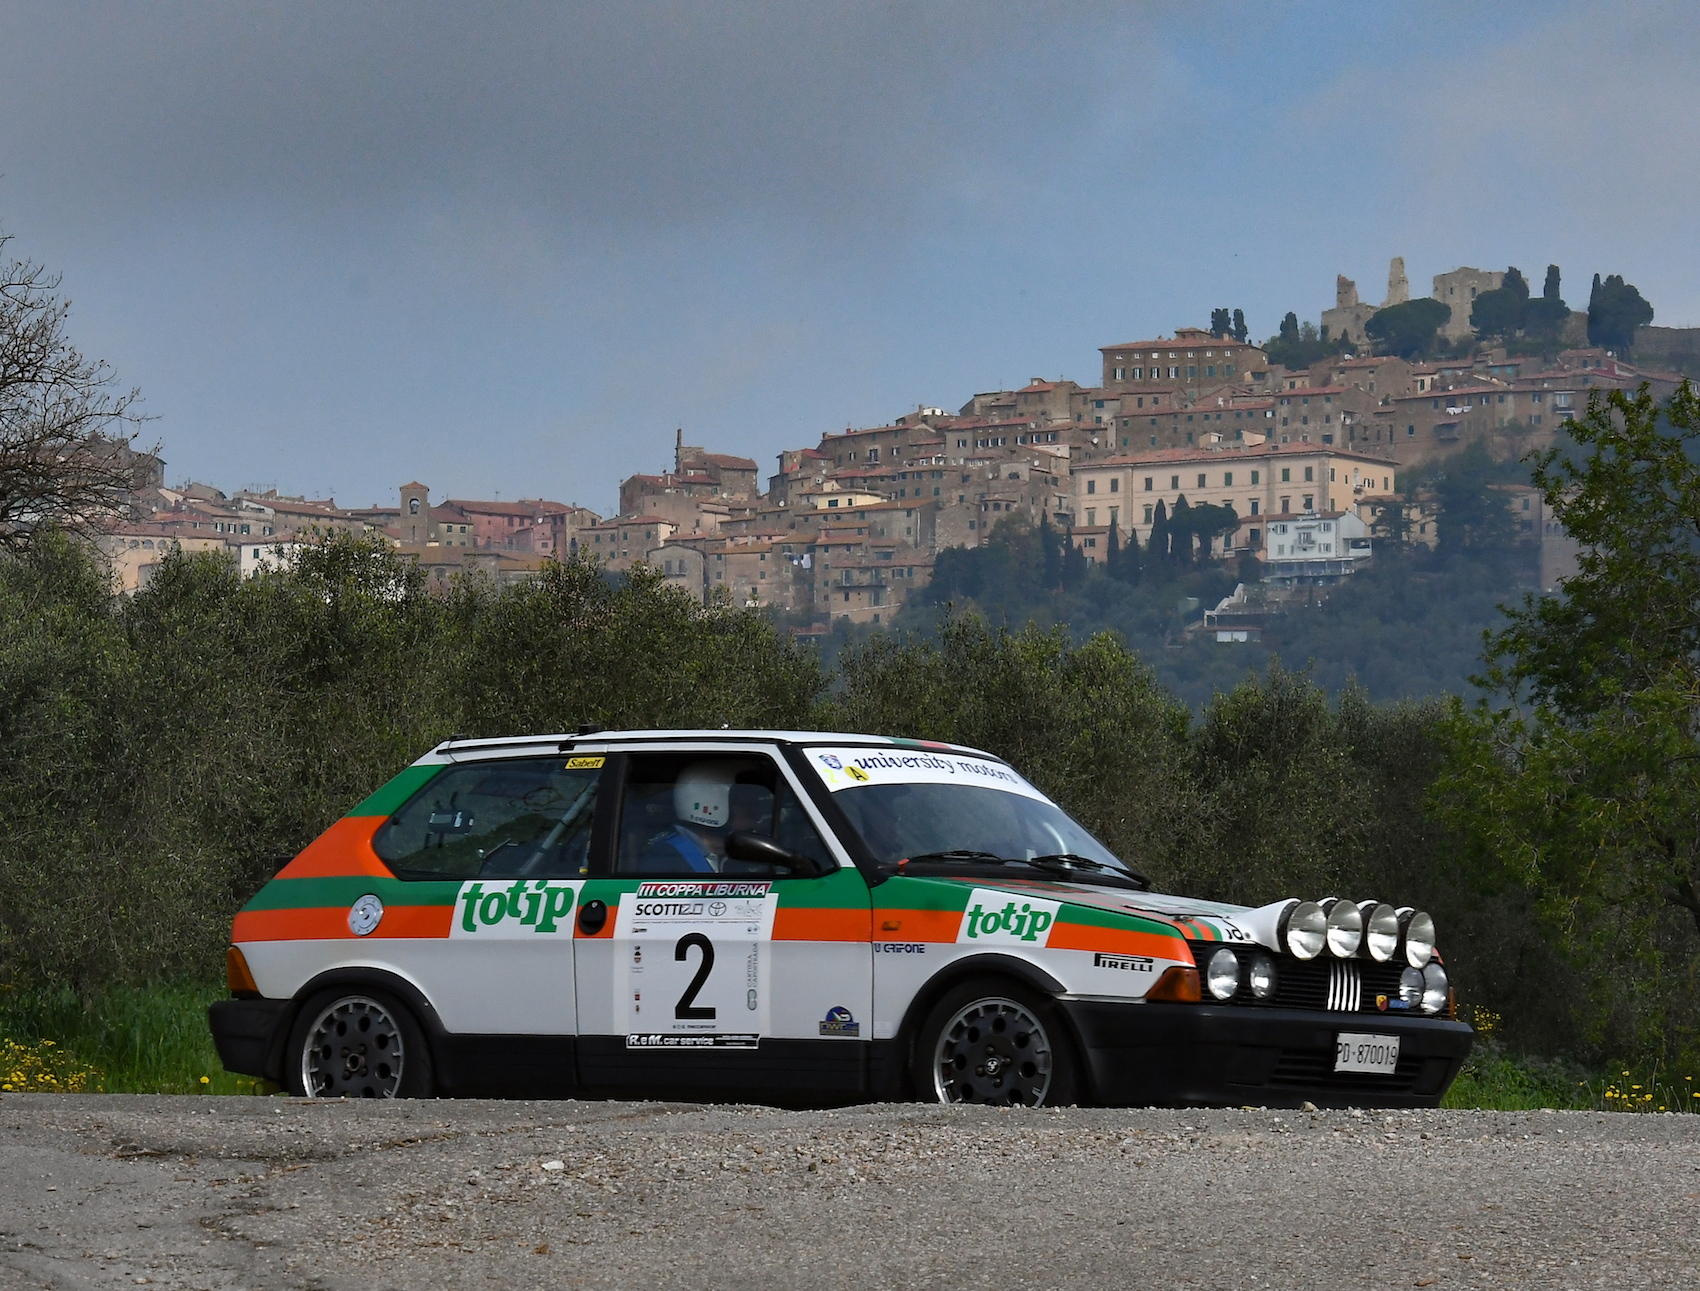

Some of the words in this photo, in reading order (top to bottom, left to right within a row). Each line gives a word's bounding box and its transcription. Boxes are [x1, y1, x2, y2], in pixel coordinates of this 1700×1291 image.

[849, 767, 866, 781] A
[854, 752, 955, 775] university
[957, 761, 1018, 785] motors
[656, 884, 703, 897] COPPA
[704, 884, 766, 896] LIBURNA
[461, 880, 575, 933] totip
[966, 902, 1052, 942] totip
[674, 931, 716, 1020] 2
[1094, 953, 1154, 972] PIRELLI
[680, 1036, 715, 1046] service
